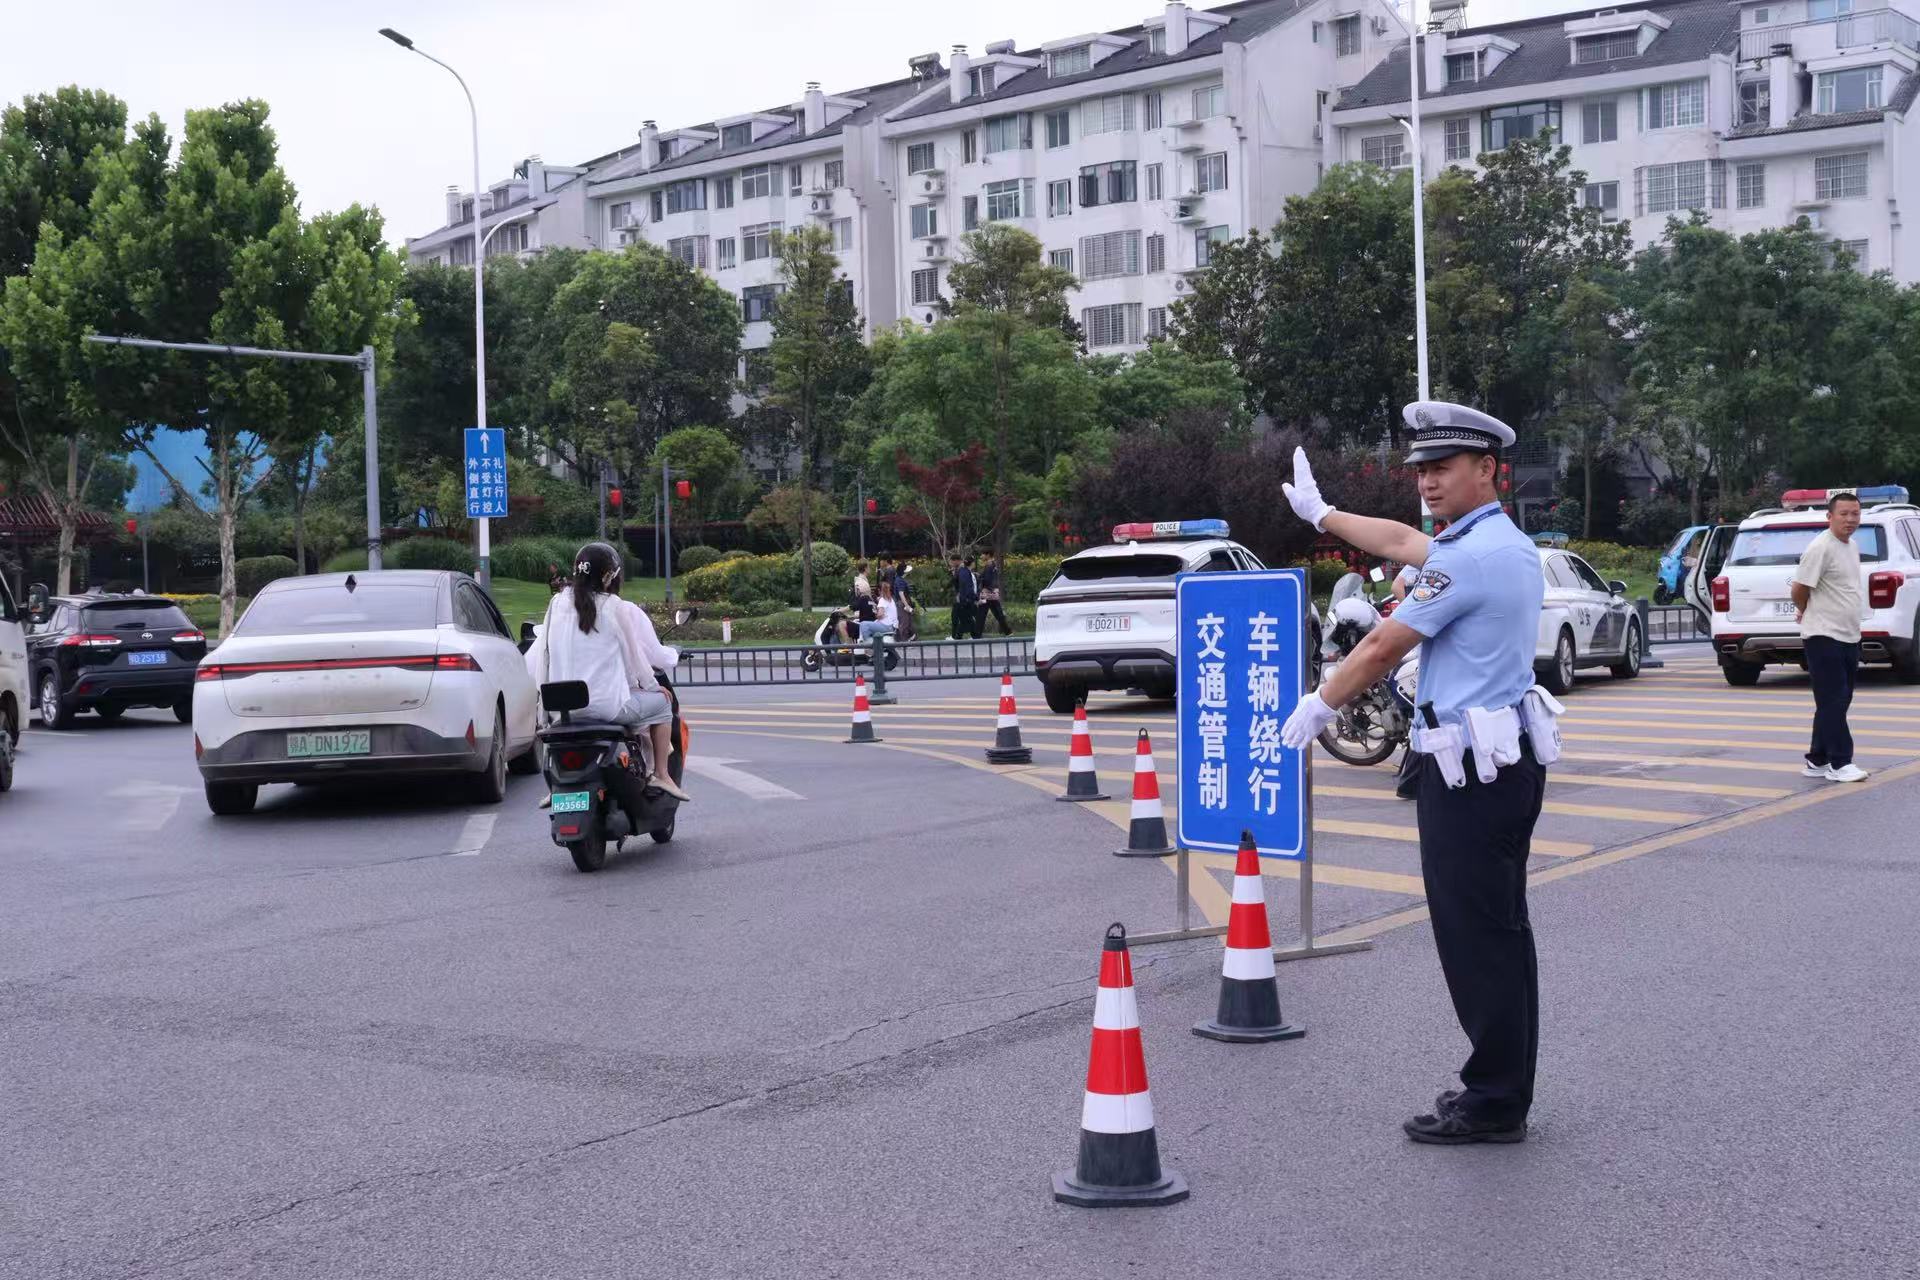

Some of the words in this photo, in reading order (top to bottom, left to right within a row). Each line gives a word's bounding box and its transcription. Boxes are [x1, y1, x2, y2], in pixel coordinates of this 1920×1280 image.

[468, 457, 480, 514] 外侧直行
[482, 458, 493, 513] 不受灯控
[493, 457, 505, 513] 礼让行人
[1155, 522, 1178, 531] POLICE
[1196, 612, 1228, 810] 交通管制
[1247, 611, 1281, 816] 车辆绕行
[553, 800, 587, 810] H23565
